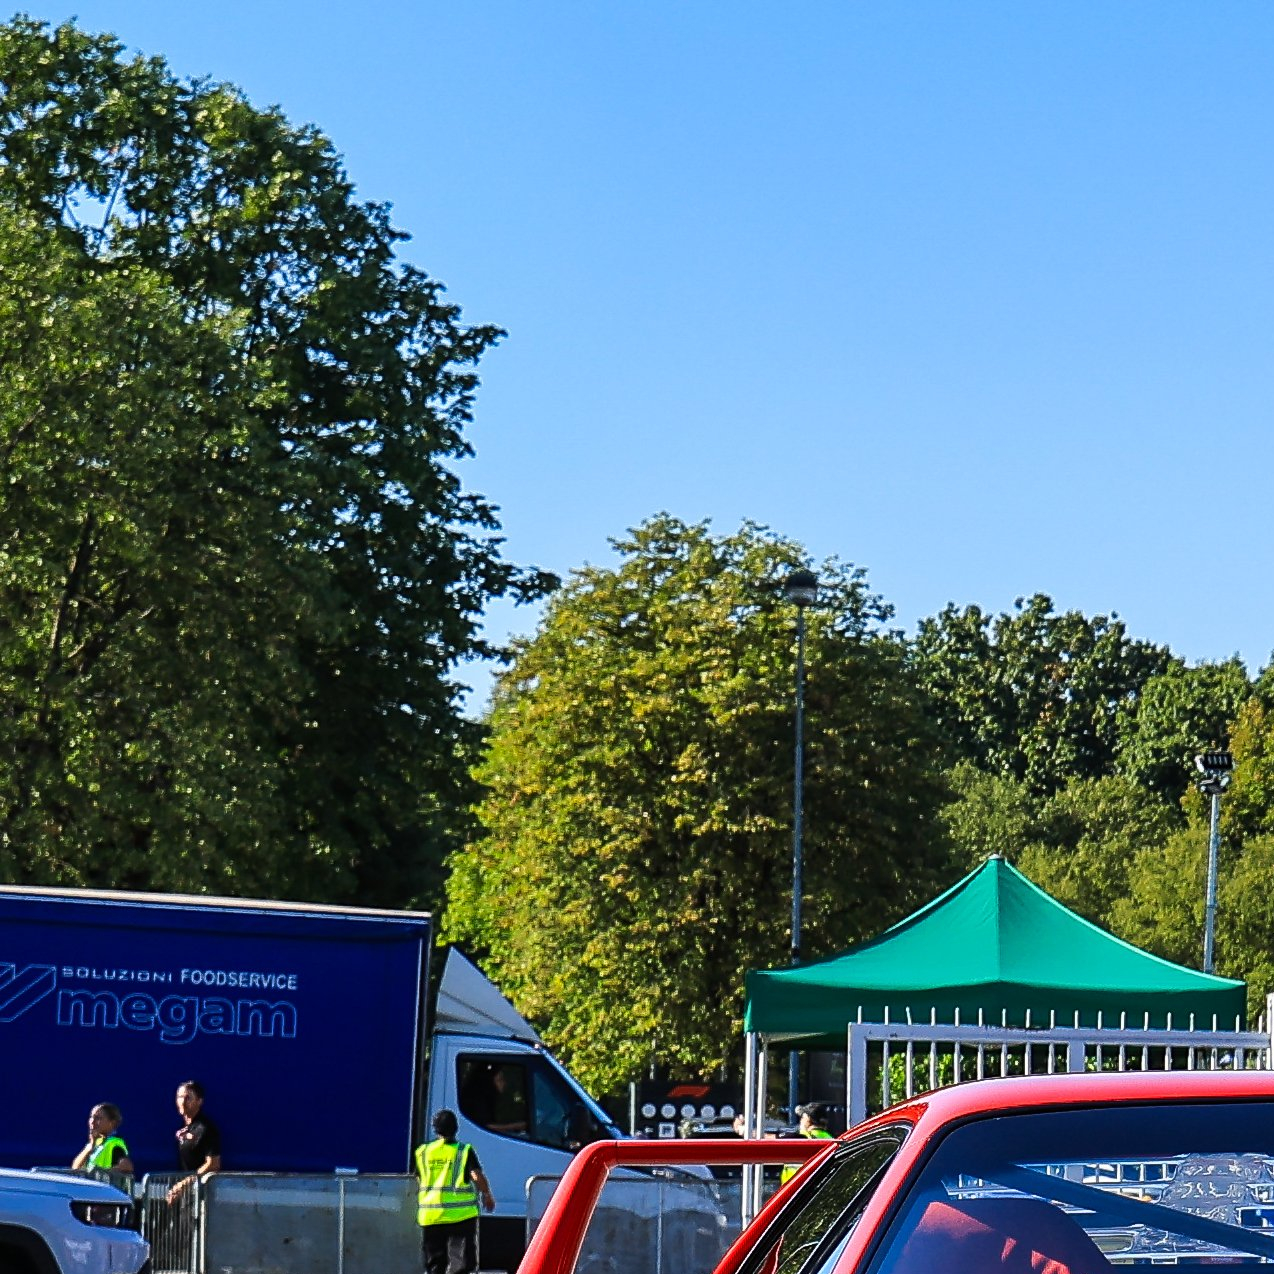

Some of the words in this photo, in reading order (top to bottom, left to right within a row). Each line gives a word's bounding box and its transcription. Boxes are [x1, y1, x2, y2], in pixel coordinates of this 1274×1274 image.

[61, 966, 172, 983] SOLUZIONI
[180, 968, 298, 990] FOODSERVICE
[57, 988, 297, 1044] megam
